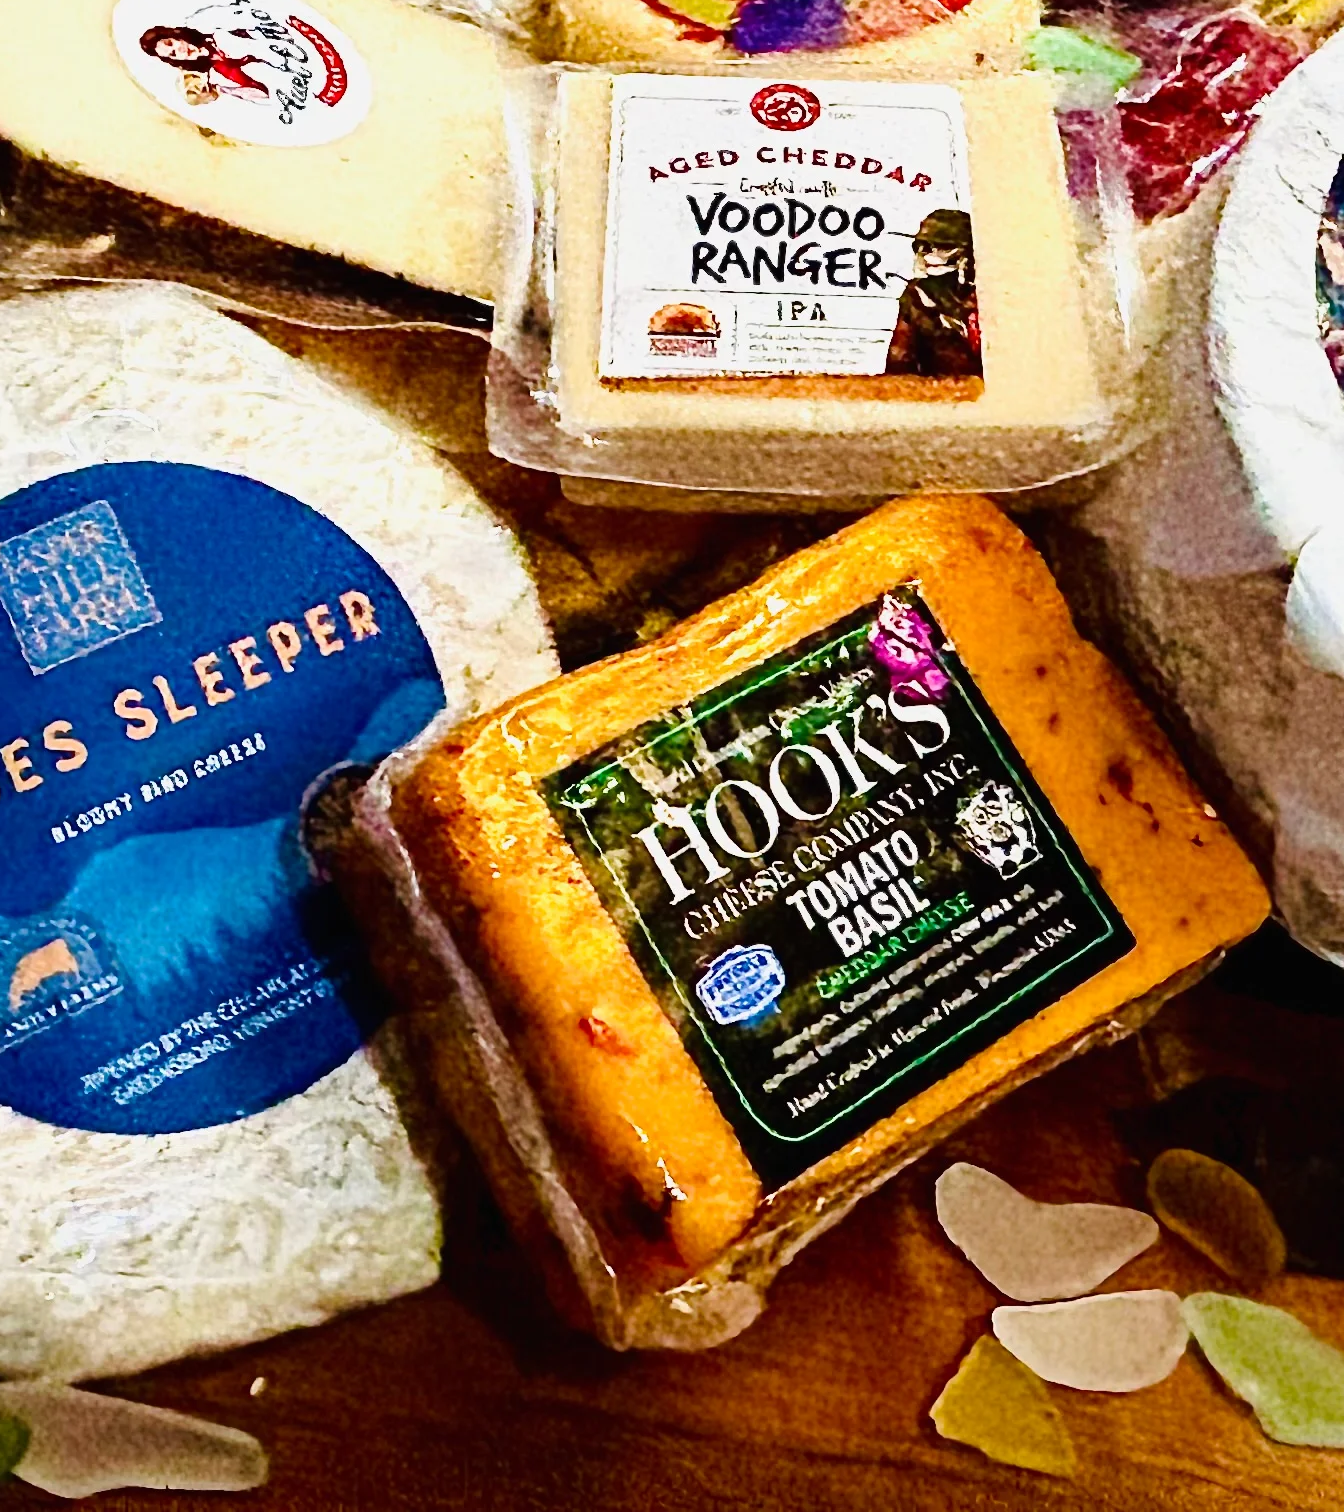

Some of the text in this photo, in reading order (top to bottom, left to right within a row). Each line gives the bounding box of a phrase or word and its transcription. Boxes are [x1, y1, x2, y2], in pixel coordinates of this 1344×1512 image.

[648, 146, 932, 192] AGED CHEDDAR
[686, 192, 885, 241] VOODOO
[691, 241, 887, 290] RANGER
[776, 300, 828, 321] IPA
[113, 590, 381, 741] SLEEPER
[631, 681, 951, 906] HOOK'S
[684, 860, 795, 940] CHEESE
[786, 829, 919, 931] TOMATO
[827, 888, 932, 958] BASIL
